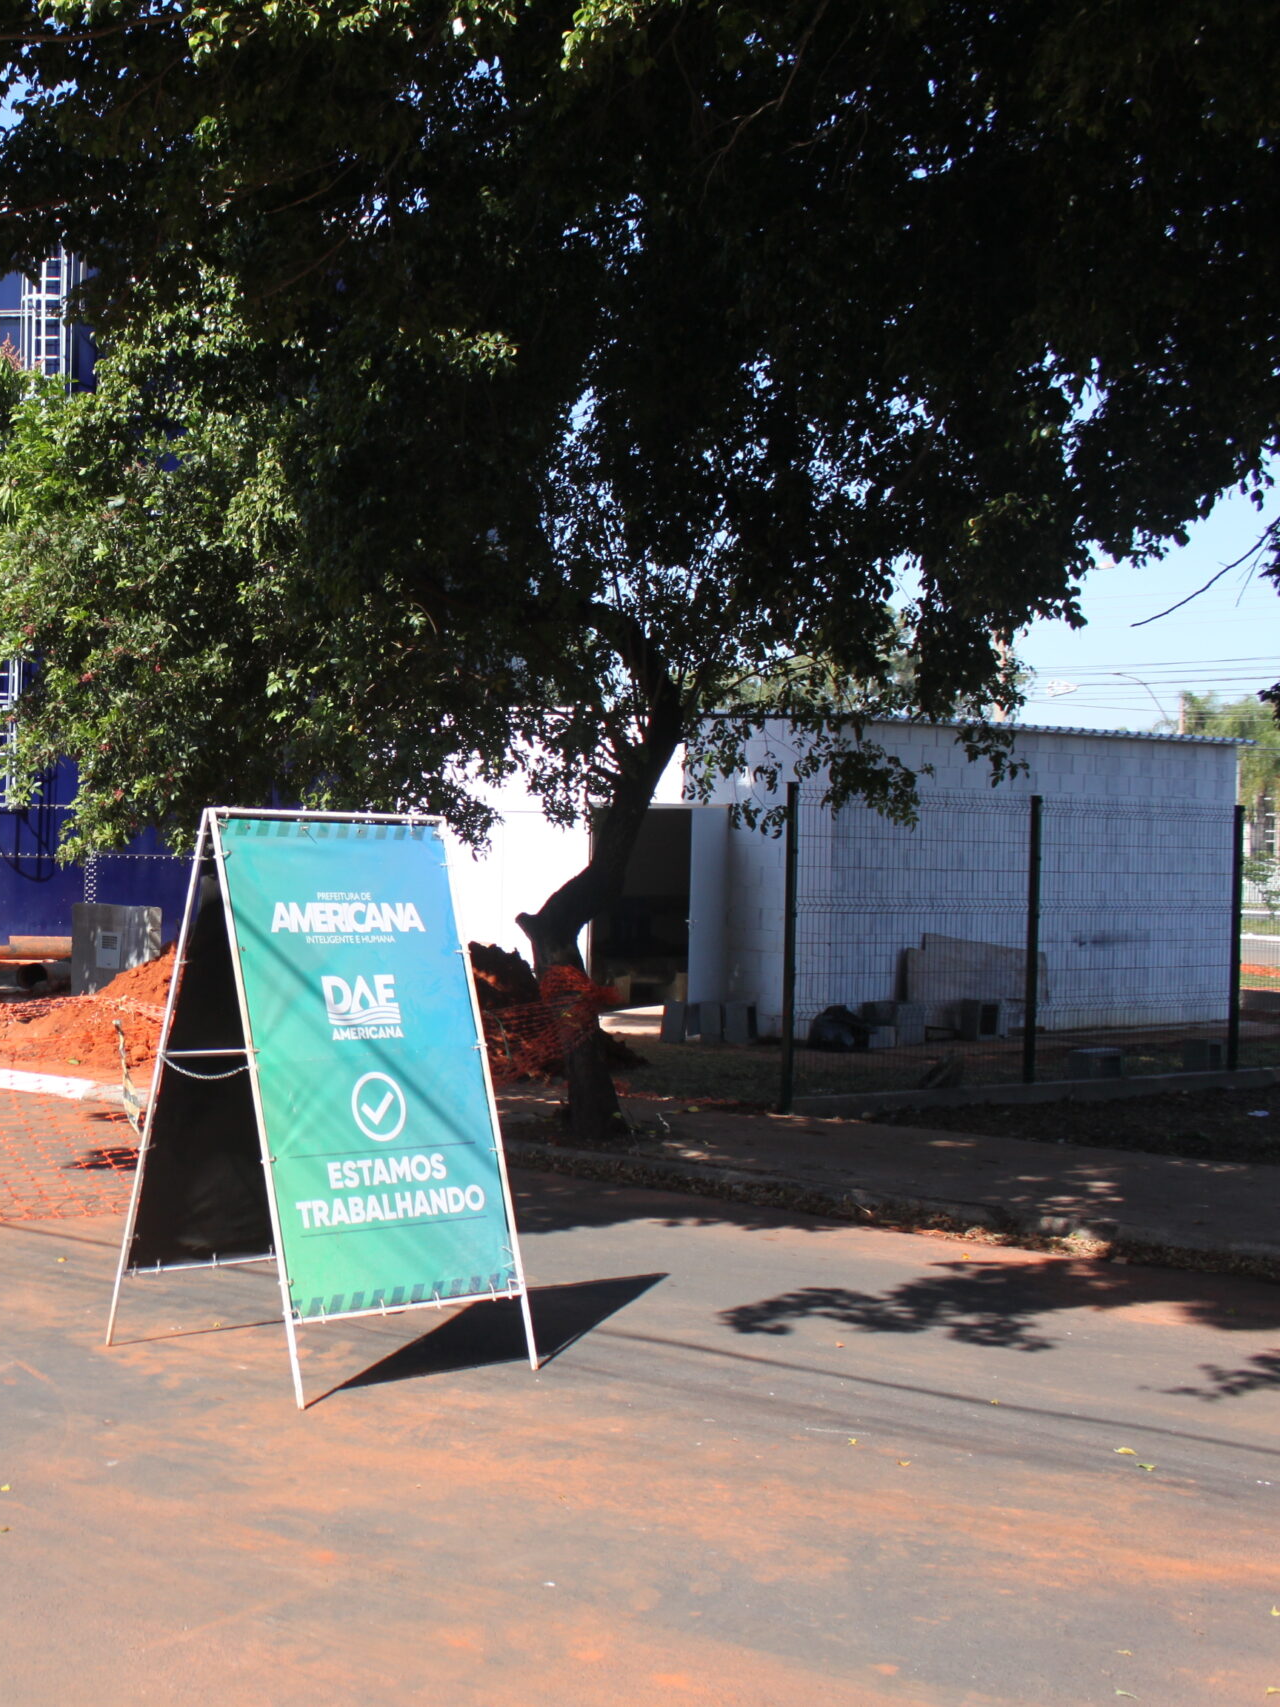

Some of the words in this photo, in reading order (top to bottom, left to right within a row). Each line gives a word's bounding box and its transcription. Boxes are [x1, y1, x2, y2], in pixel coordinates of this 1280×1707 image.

[317, 892, 359, 900] PREFEITURA
[361, 892, 371, 900] DE
[271, 902, 426, 933] AMERICANA
[306, 935, 354, 943] INTELIGENTE
[362, 935, 395, 943] HUMANA
[321, 974, 399, 1014] DAE
[332, 1025, 404, 1040] AMERICANA
[327, 1152, 447, 1189] ESTAMOS
[295, 1184, 485, 1229] TRABALHANDO
